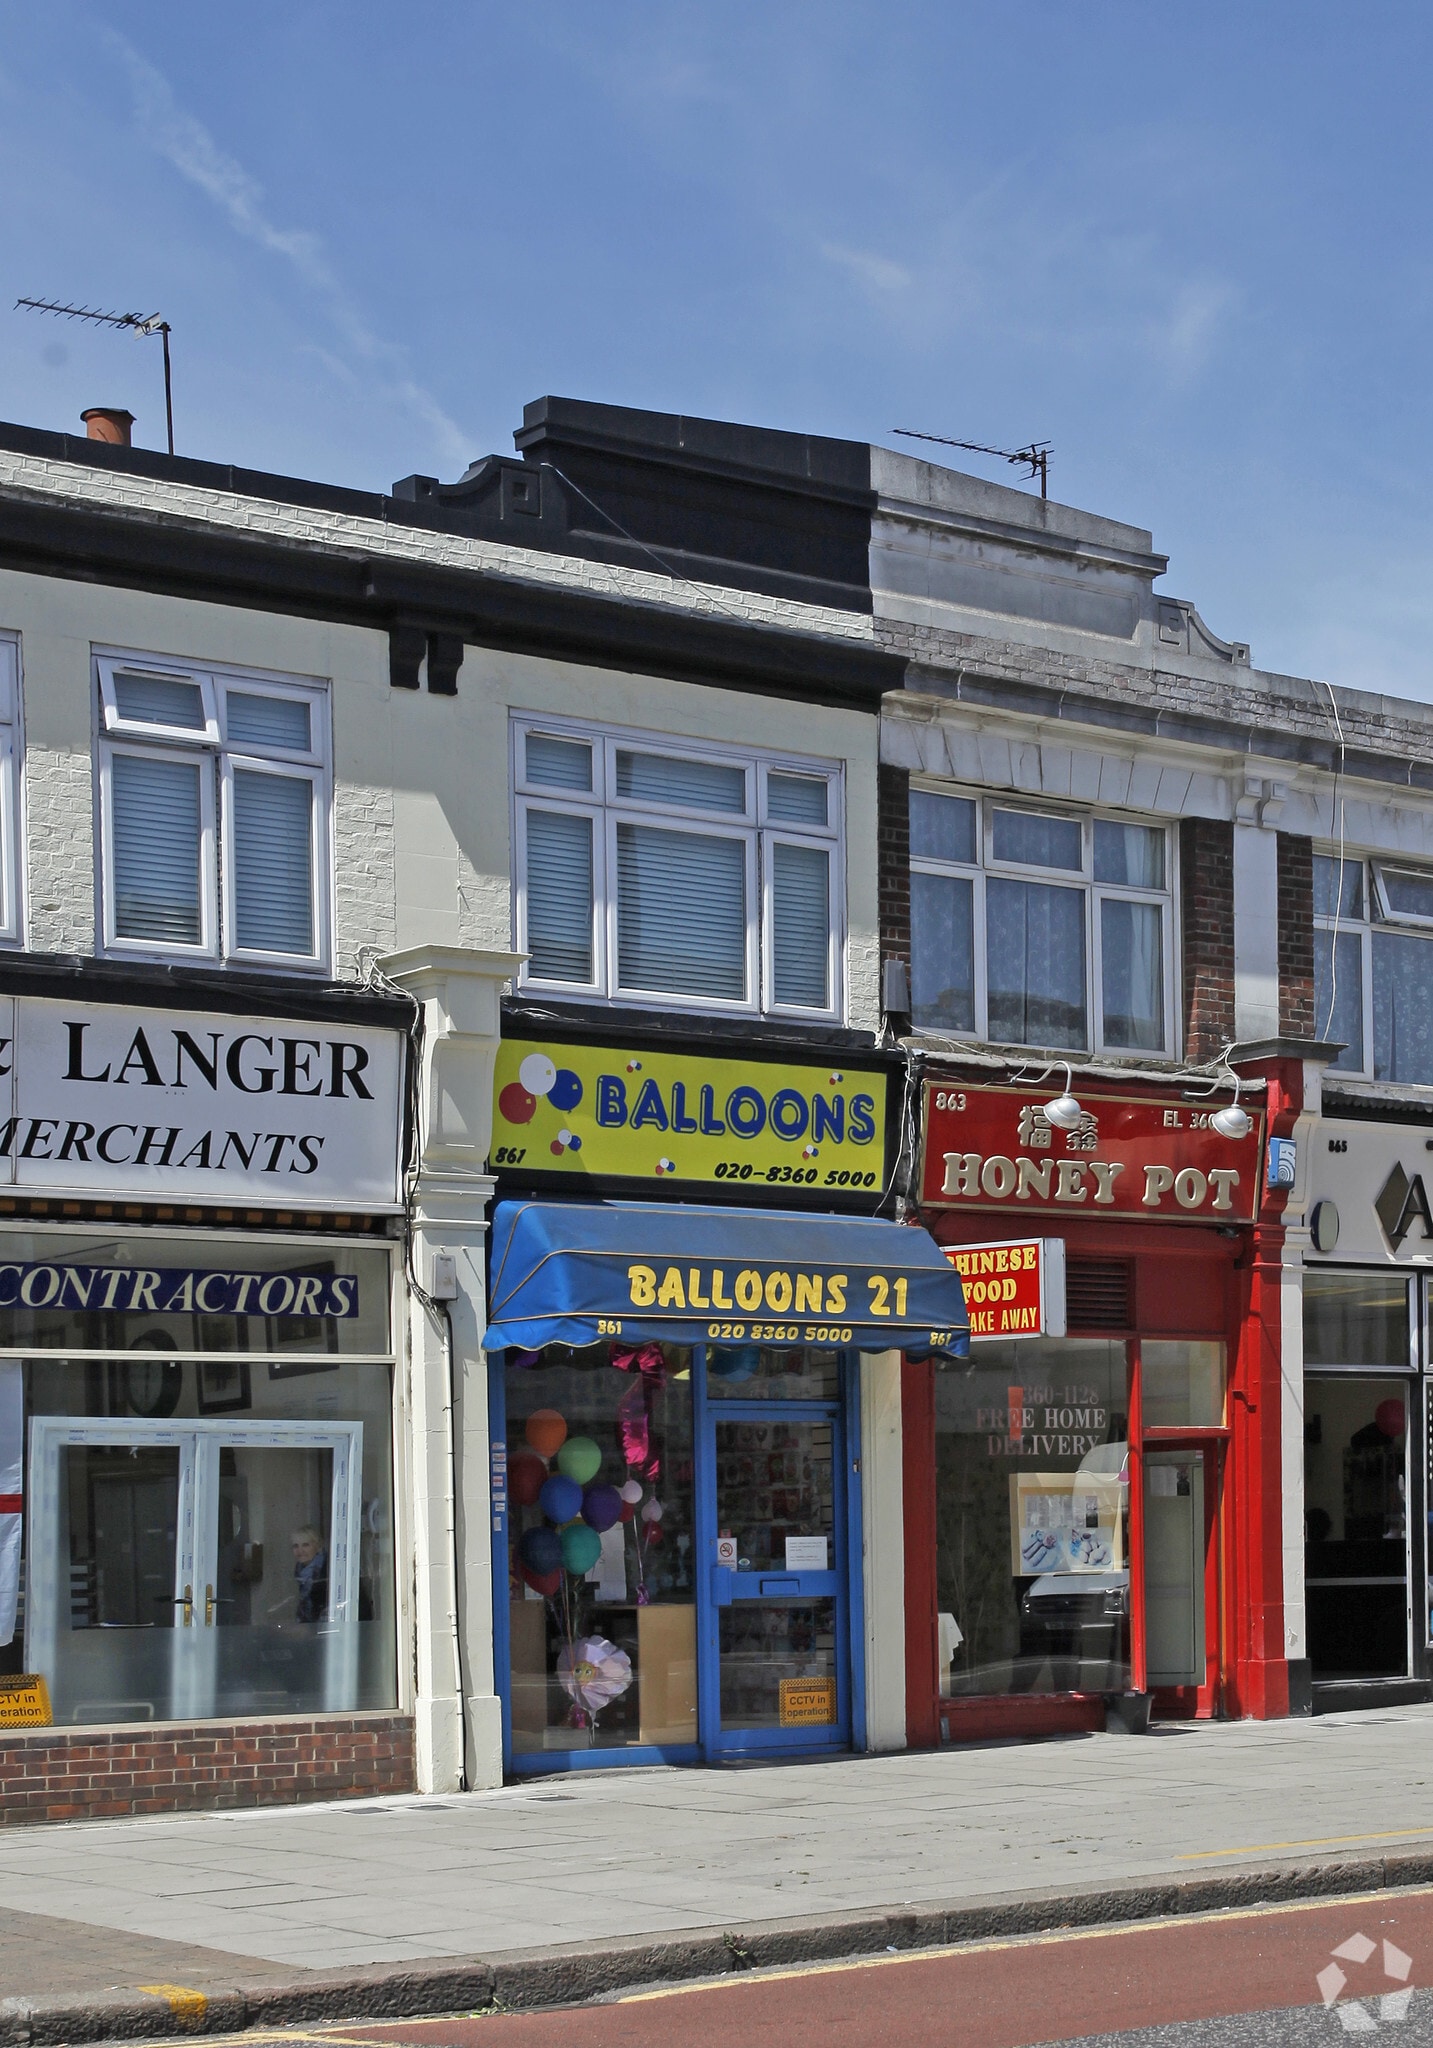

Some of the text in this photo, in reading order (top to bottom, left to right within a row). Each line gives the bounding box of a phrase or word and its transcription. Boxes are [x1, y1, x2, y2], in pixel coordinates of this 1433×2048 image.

[61, 1021, 375, 1100] LANGER
[596, 1074, 876, 1146] BALLOONS
[935, 1092, 967, 1111] 863
[495, 1147, 526, 1164] 861
[1328, 1140, 1348, 1153] 865
[714, 1163, 876, 1188] 020-8360 5000
[941, 1152, 1240, 1211] HONEY POT
[0, 1265, 357, 1317] CONTRACTORS
[628, 1264, 908, 1316] BALLOONS 21
[961, 1278, 1017, 1304] FOOD
[597, 1320, 622, 1335] 861
[967, 1307, 1037, 1333] AKE AWAY
[708, 1323, 853, 1343] 020 8360 5000
[929, 1332, 952, 1347] 861
[976, 1407, 1106, 1429] FREE HOME
[987, 1434, 1100, 1456] DELIVERY
[24, 1693, 36, 1703] in
[790, 1696, 826, 1705] CCTV in
[787, 1708, 829, 1719] operation
